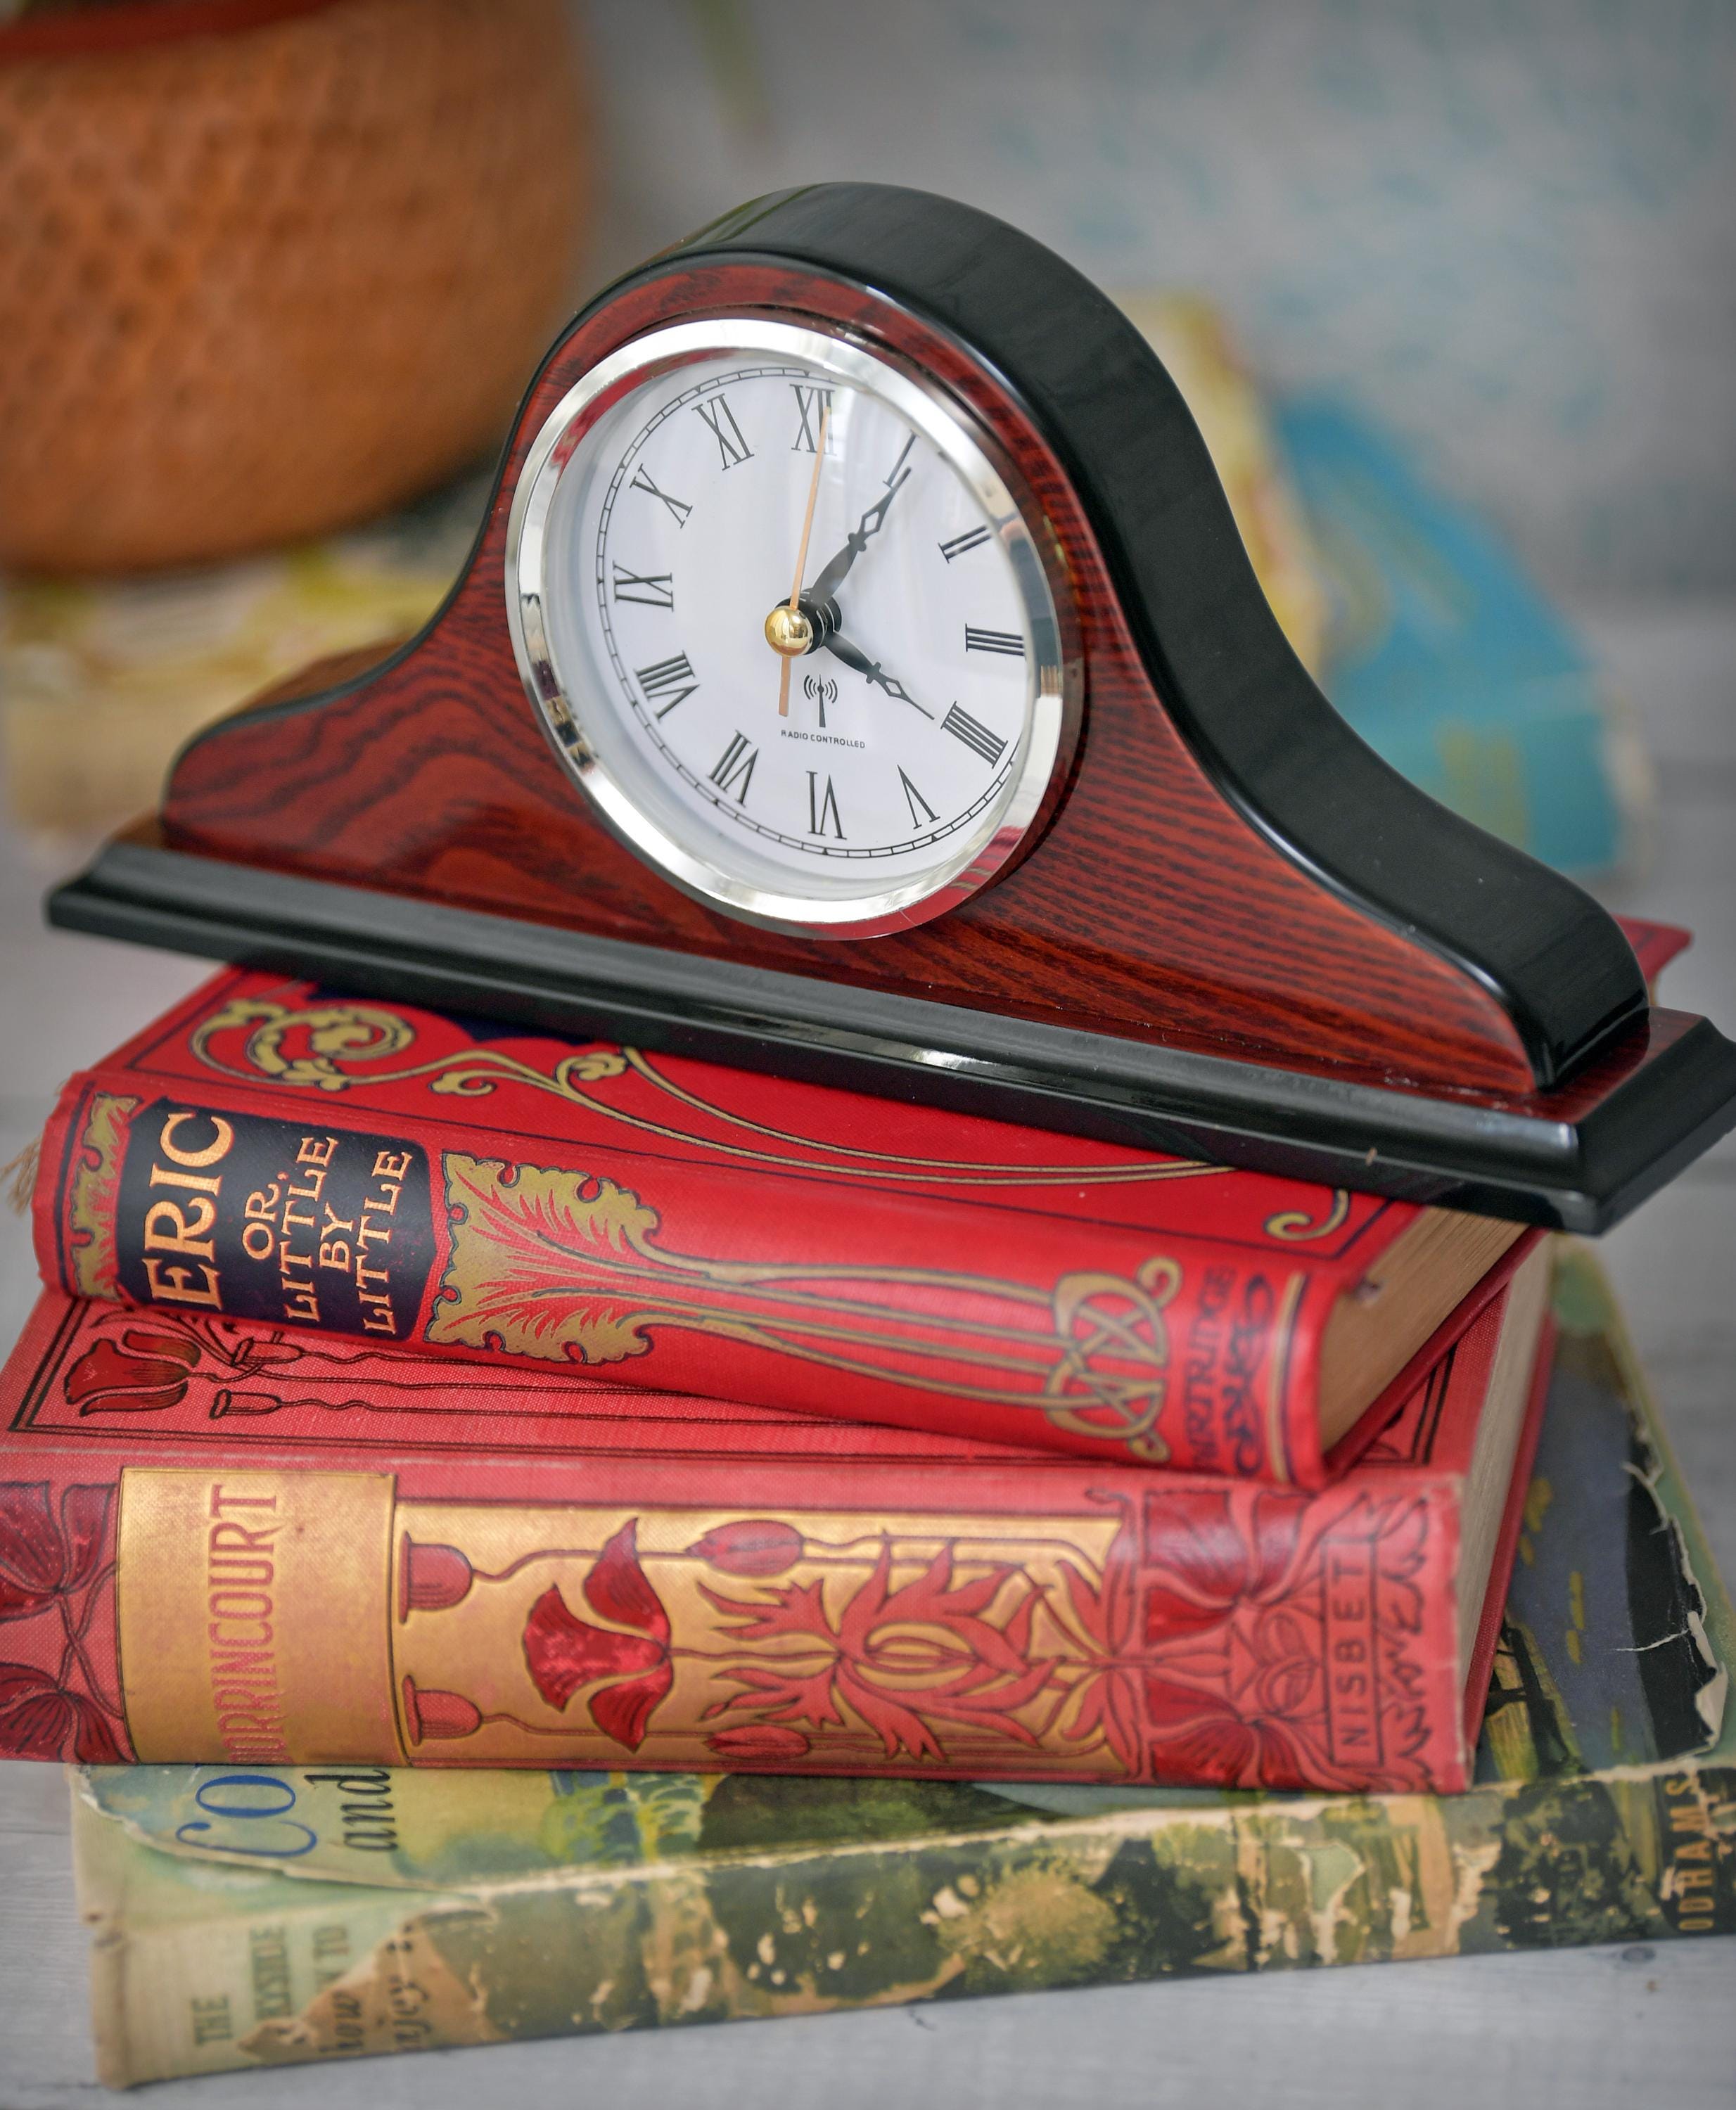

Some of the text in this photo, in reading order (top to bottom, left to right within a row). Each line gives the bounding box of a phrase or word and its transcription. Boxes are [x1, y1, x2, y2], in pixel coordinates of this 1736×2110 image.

[691, 393, 755, 471] XI
[789, 383, 837, 456] XII
[630, 463, 694, 529] X
[938, 525, 993, 563] II
[612, 561, 675, 612] IX
[964, 623, 1025, 656] III
[634, 650, 701, 720] VIII
[707, 729, 760, 808] VII
[781, 729, 865, 748] RADIO CONTROLLED
[940, 701, 1008, 769] IIII
[805, 769, 848, 840] VI
[897, 765, 940, 830] V
[141, 1111, 235, 1311] ERIC
[241, 1171, 289, 1260] OR,
[279, 1135, 340, 1323] LITTLE
[318, 1201, 354, 1273] BY
[352, 1149, 414, 1336] LITTLE
[1331, 1556, 1366, 1748] NISBET
[304, 1768, 398, 1853] and
[1666, 1777, 1716, 1931] ODHAMS
[191, 1994, 233, 2047] THE
